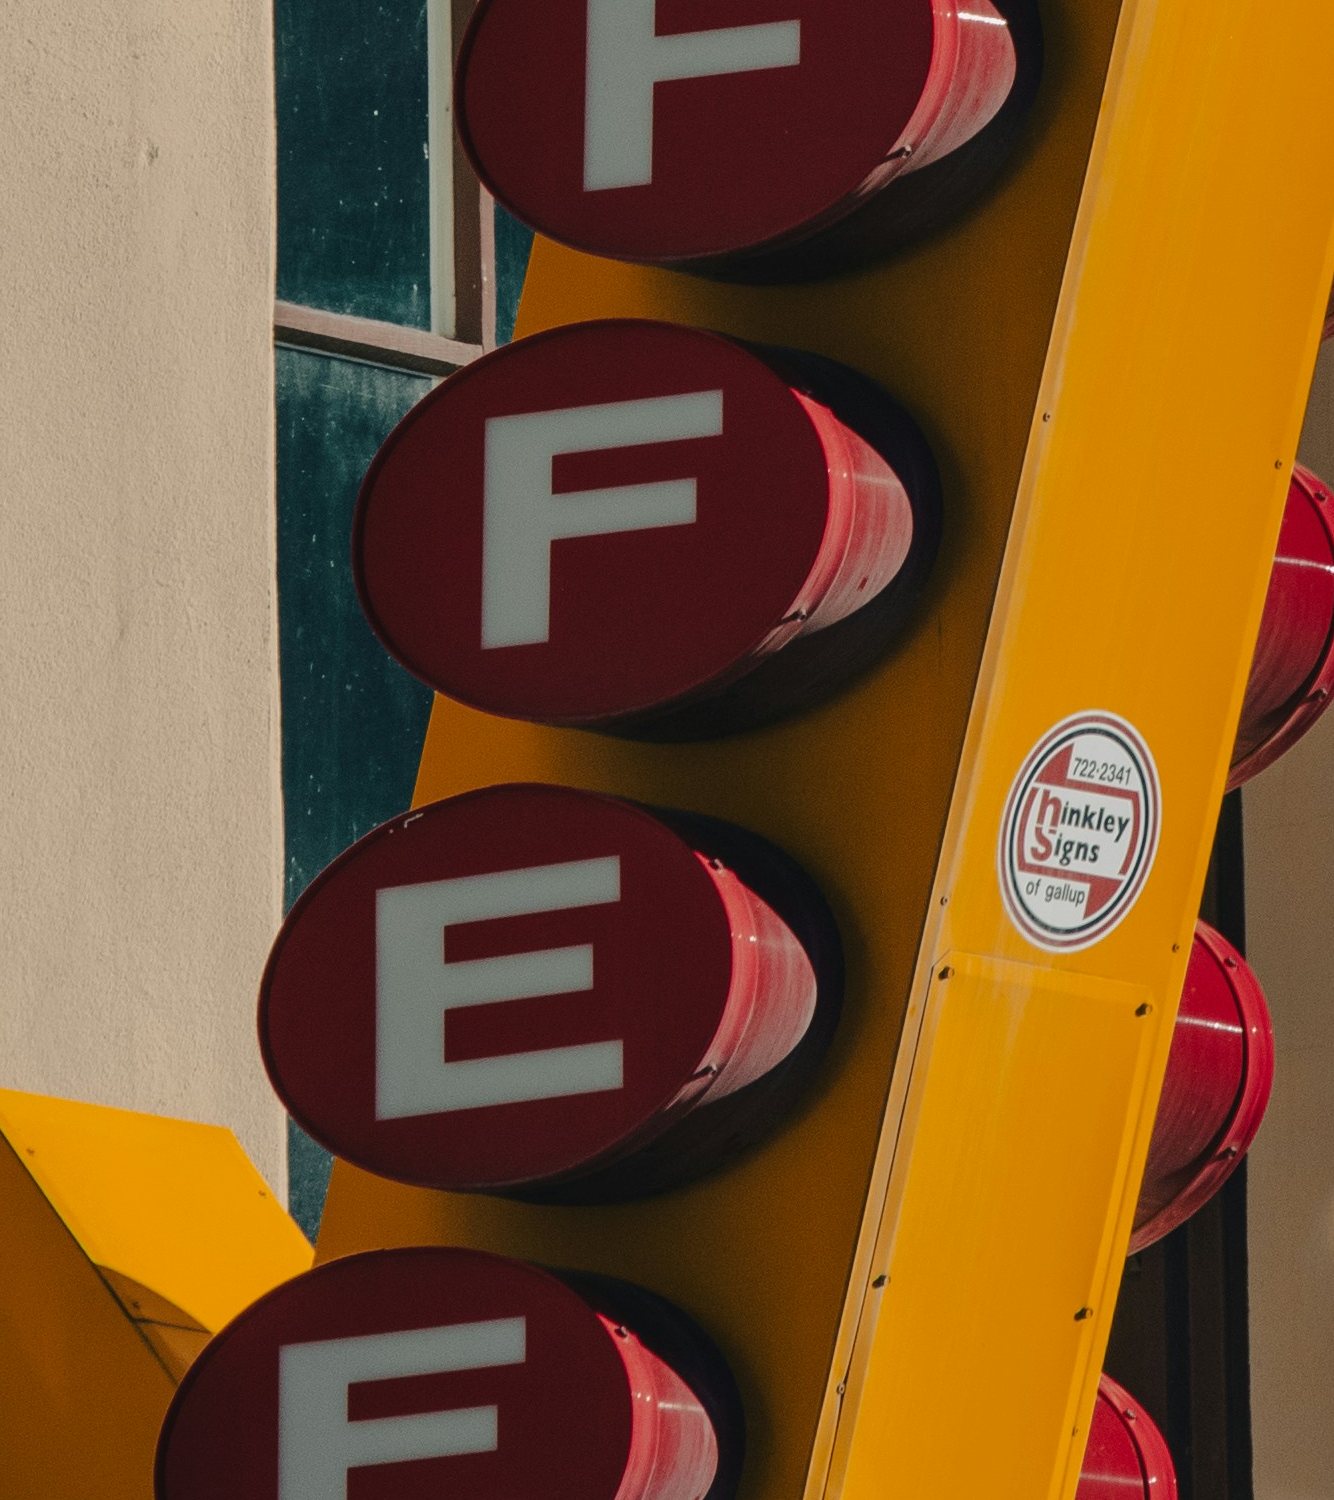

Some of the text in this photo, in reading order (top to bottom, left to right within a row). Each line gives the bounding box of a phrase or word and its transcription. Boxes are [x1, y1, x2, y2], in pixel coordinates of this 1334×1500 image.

[1030, 824, 1101, 866] Signs
[1024, 878, 1086, 907] of gallup
